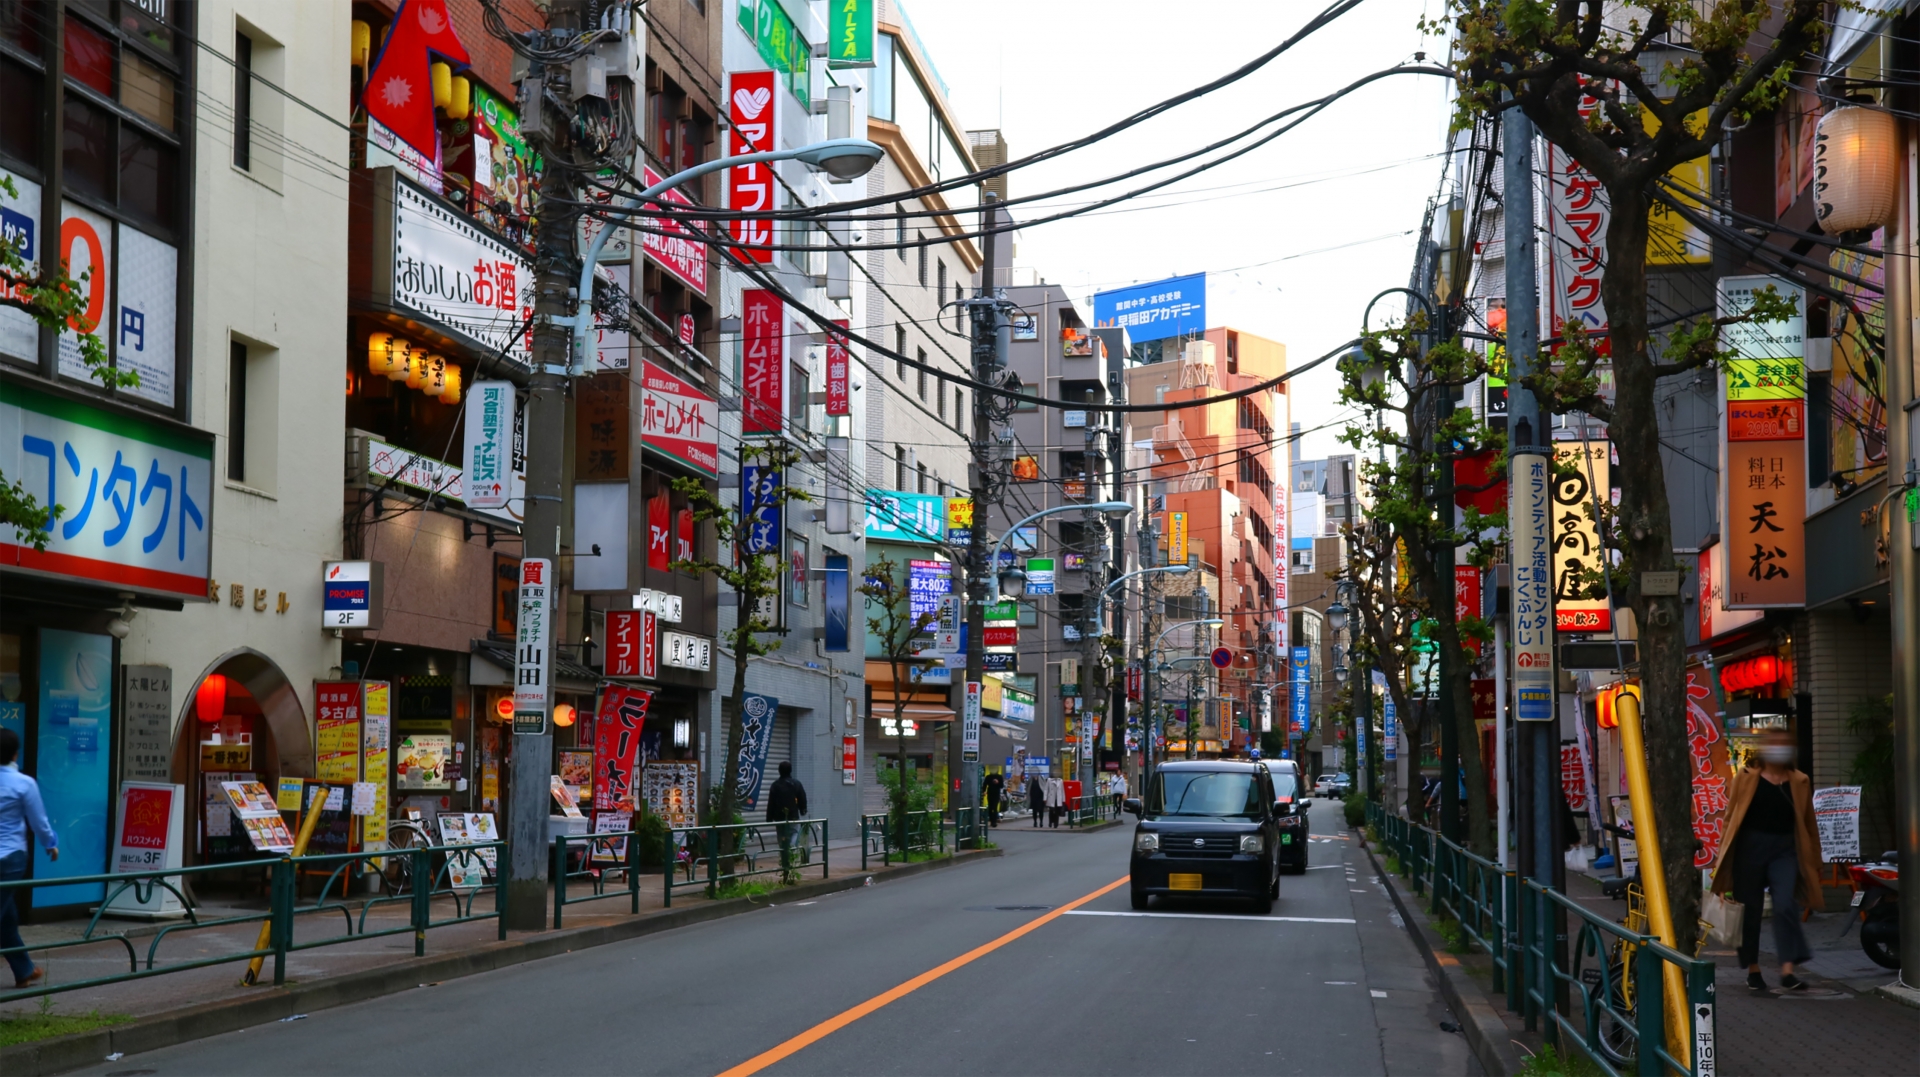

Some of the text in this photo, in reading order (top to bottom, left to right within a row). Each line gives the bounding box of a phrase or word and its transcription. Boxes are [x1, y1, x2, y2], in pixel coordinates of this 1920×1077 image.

[736, 123, 769, 245] アイフル
[402, 256, 517, 311] おいしいお酒
[1116, 290, 1182, 312] 難関中学・高校受験
[121, 305, 145, 352] 円
[1117, 303, 1201, 327] 早稲田アカデミー
[615, 358, 627, 367] 2階
[748, 302, 769, 420] ホームメイト
[770, 321, 779, 399] お部屋探しの専門店
[1756, 365, 1800, 376] 英会話
[831, 400, 847, 411] 2F
[1729, 388, 1745, 399] 3F
[643, 393, 706, 438] ホームメイト
[481, 388, 499, 480] 河合塾マナビス
[1748, 457, 1766, 489] 料理
[1769, 457, 1785, 489] 日本
[23, 434, 204, 562] コンタクト
[651, 525, 693, 562] アイ フル
[1531, 462, 1548, 646] ボランティア活動センター
[1749, 501, 1790, 582] 天松
[523, 561, 544, 585] 質
[329, 590, 365, 598] PROMISE
[521, 589, 545, 597] 買取
[1517, 567, 1532, 646] こくぶんじ
[1734, 592, 1749, 602] 1F
[338, 613, 354, 624] 2F
[617, 614, 632, 675] アイフル
[518, 644, 542, 686] 山田
[129, 677, 169, 692] 太陽ビル
[0, 707, 20, 719] ンズ
[320, 706, 358, 720] 多古屋
[1386, 705, 1395, 735] たまや
[966, 720, 977, 740] 山田
[202, 751, 250, 764] 一番搾り
[126, 835, 162, 846] ハウスメイト
[120, 851, 161, 864] 当ビル 3F
[1698, 1033, 1714, 1077] 平10年
